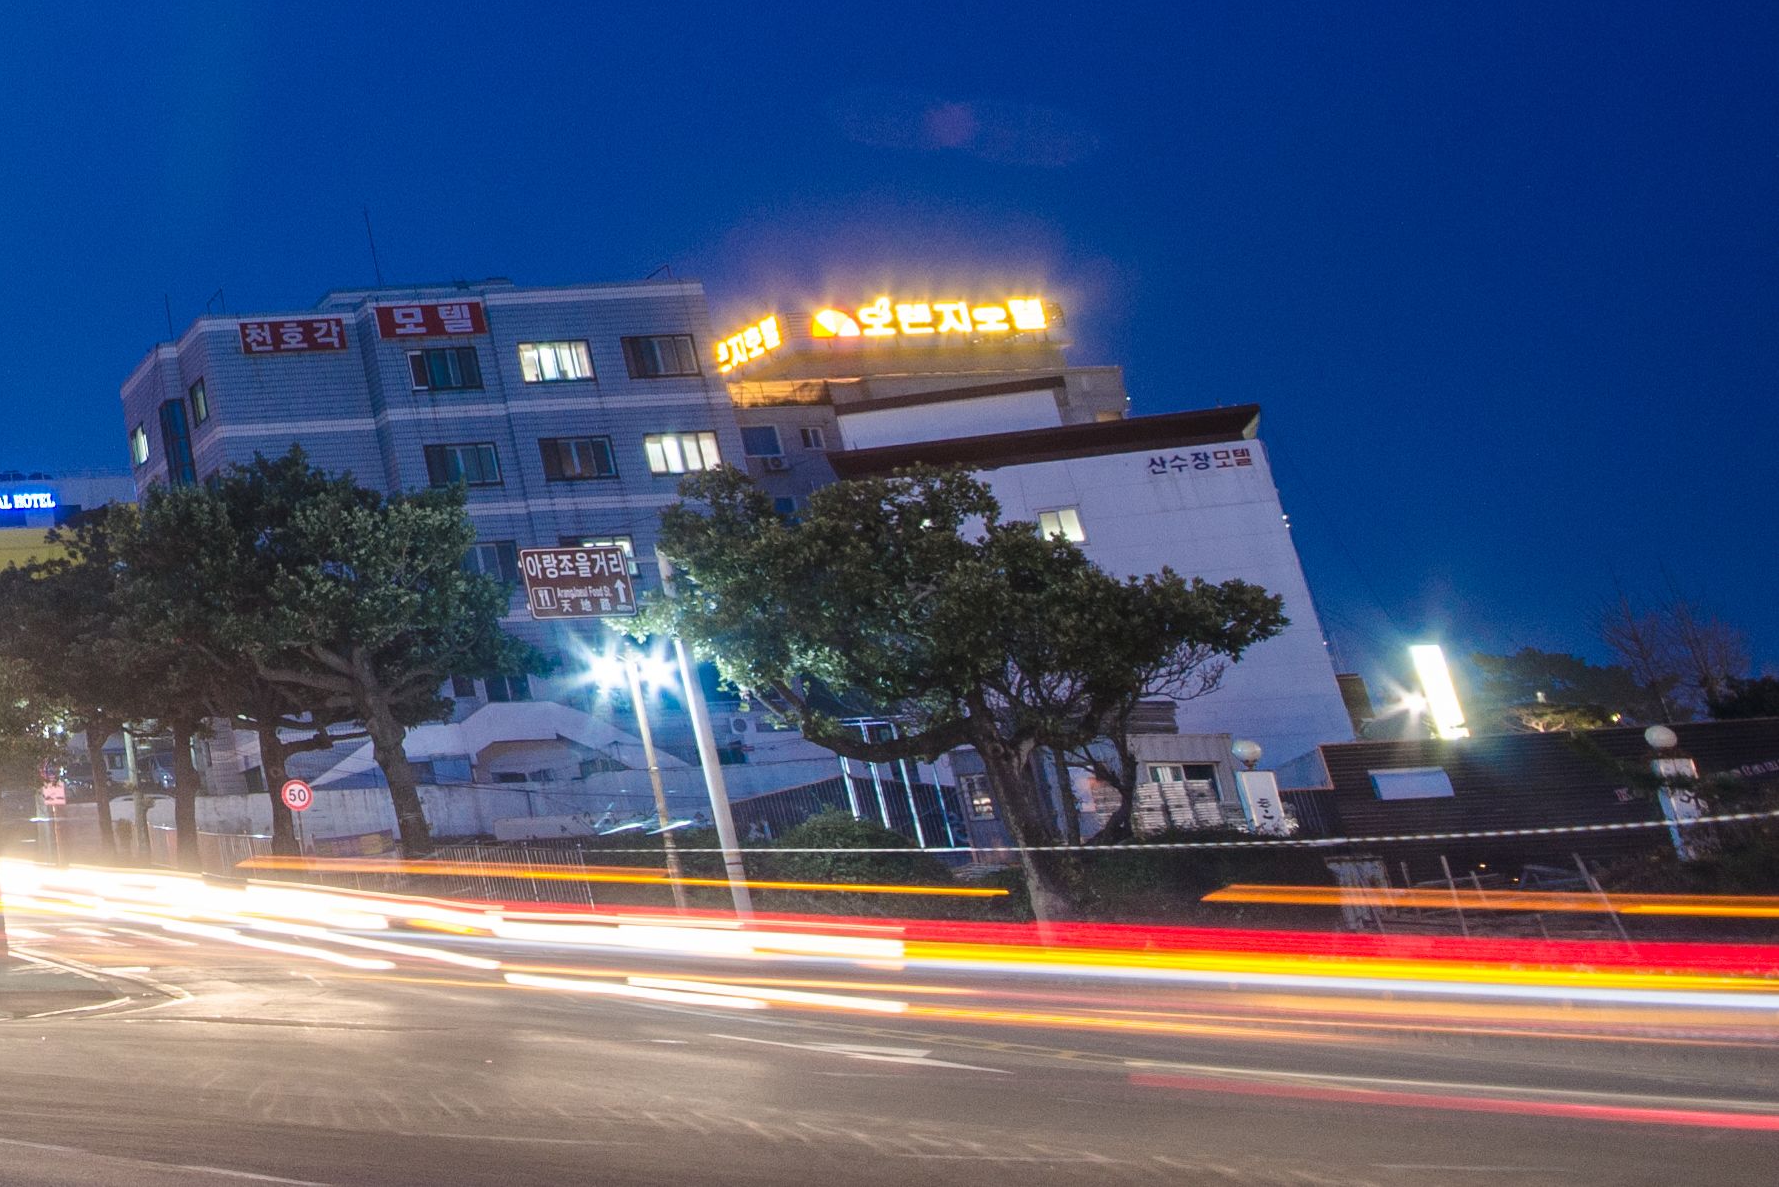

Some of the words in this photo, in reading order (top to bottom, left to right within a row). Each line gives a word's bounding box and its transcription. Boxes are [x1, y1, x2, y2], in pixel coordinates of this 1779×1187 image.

[392, 305, 474, 335] 모텔
[245, 320, 340, 351] 천호각
[14, 493, 55, 509] HOTEL
[526, 551, 627, 579] 아랑조을거리
[589, 586, 603, 597] Food
[289, 789, 306, 802] 50
